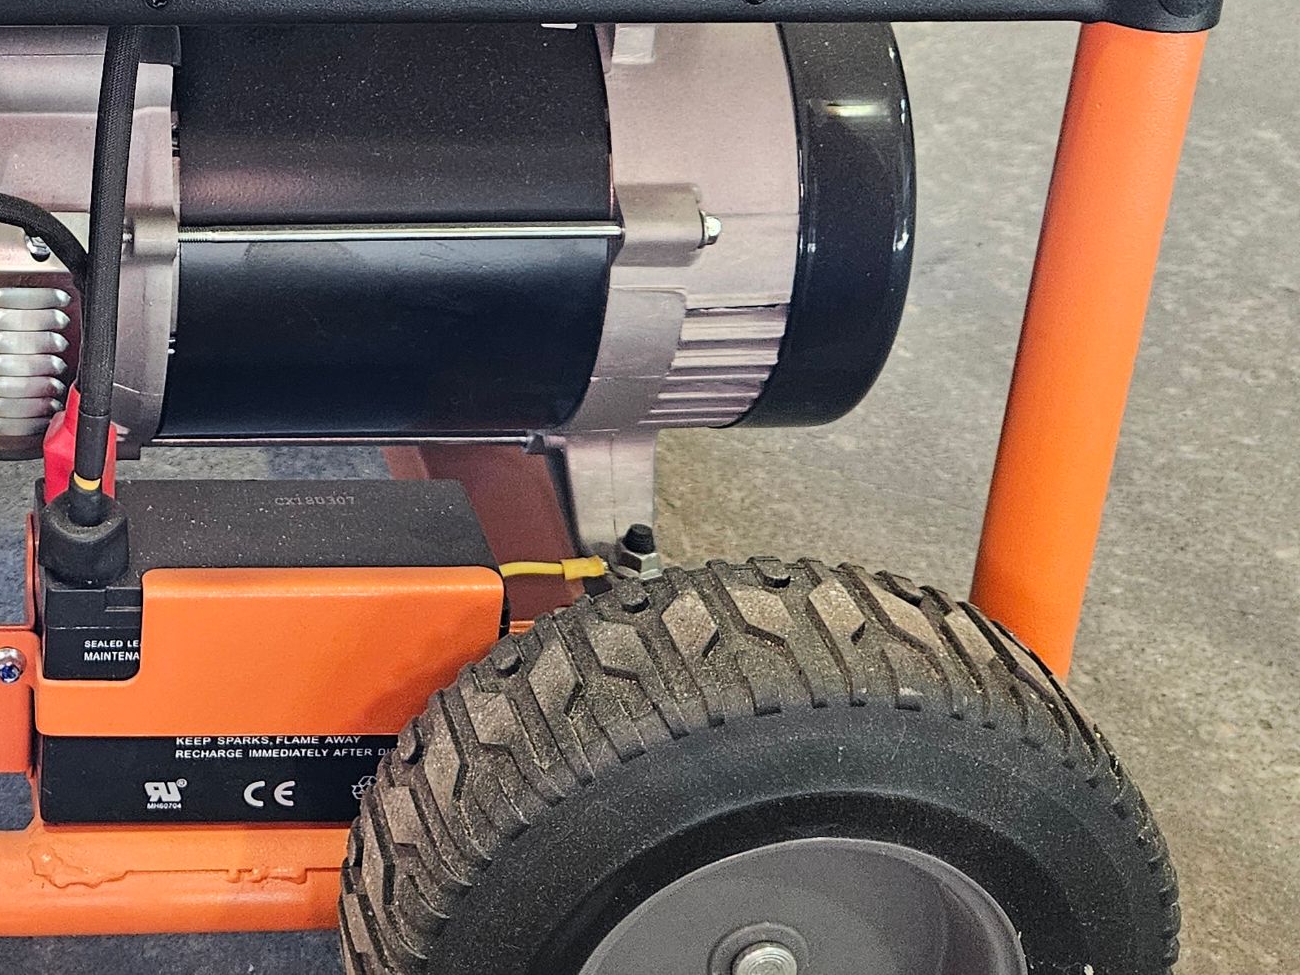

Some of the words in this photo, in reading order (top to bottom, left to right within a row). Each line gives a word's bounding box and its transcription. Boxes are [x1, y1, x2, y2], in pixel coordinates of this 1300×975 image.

[84, 640, 123, 648] SEALED
[127, 640, 140, 648] LE
[84, 651, 140, 661] MAINTENA
[175, 736, 211, 746] KEEP
[276, 736, 319, 745] FLAME
[325, 735, 361, 744] AWAY
[175, 749, 243, 758] RECHARGE
[249, 748, 329, 758] IMMEDIATELY
[333, 748, 373, 757] AFTER
